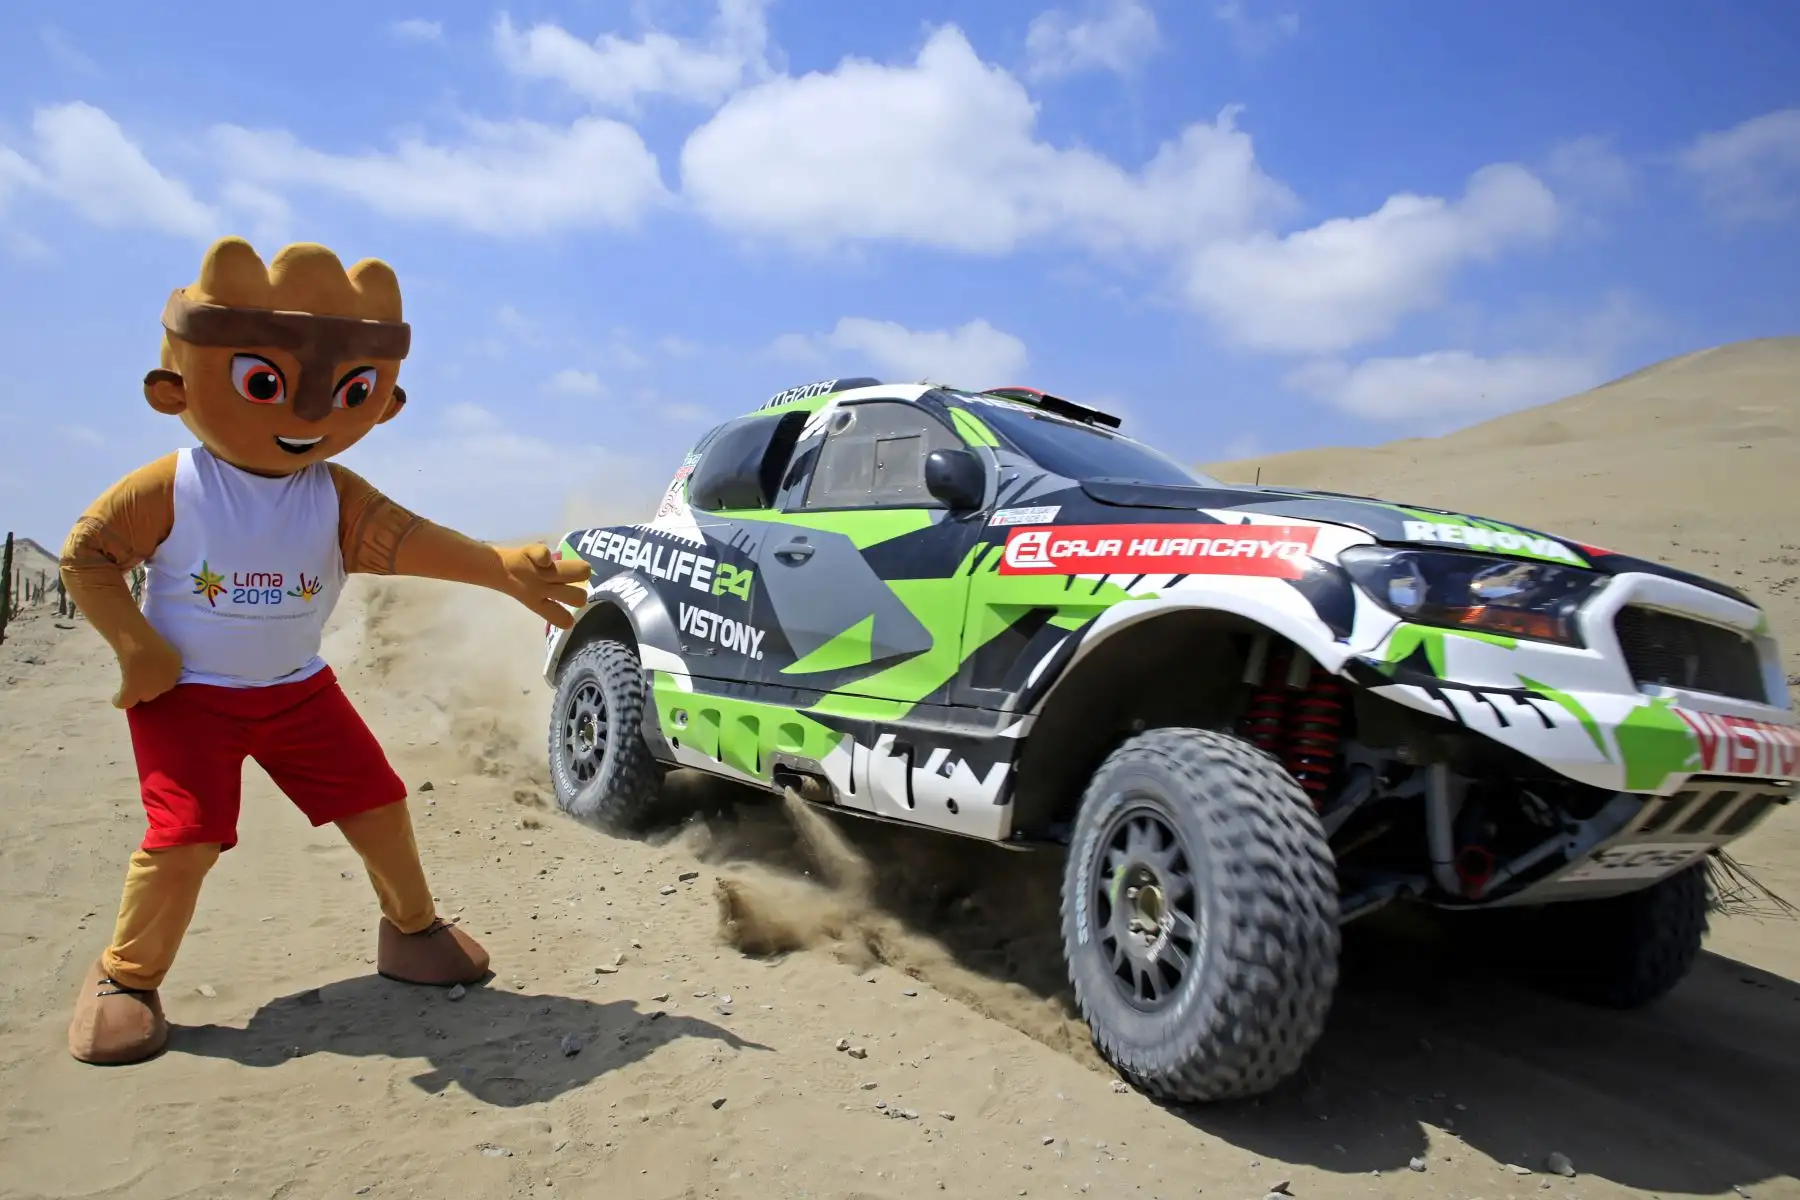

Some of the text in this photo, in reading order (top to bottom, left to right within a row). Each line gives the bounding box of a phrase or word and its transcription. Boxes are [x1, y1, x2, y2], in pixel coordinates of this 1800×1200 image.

[1051, 538, 1308, 561] CAJA HUANCAYO
[232, 588, 282, 605] 2019
